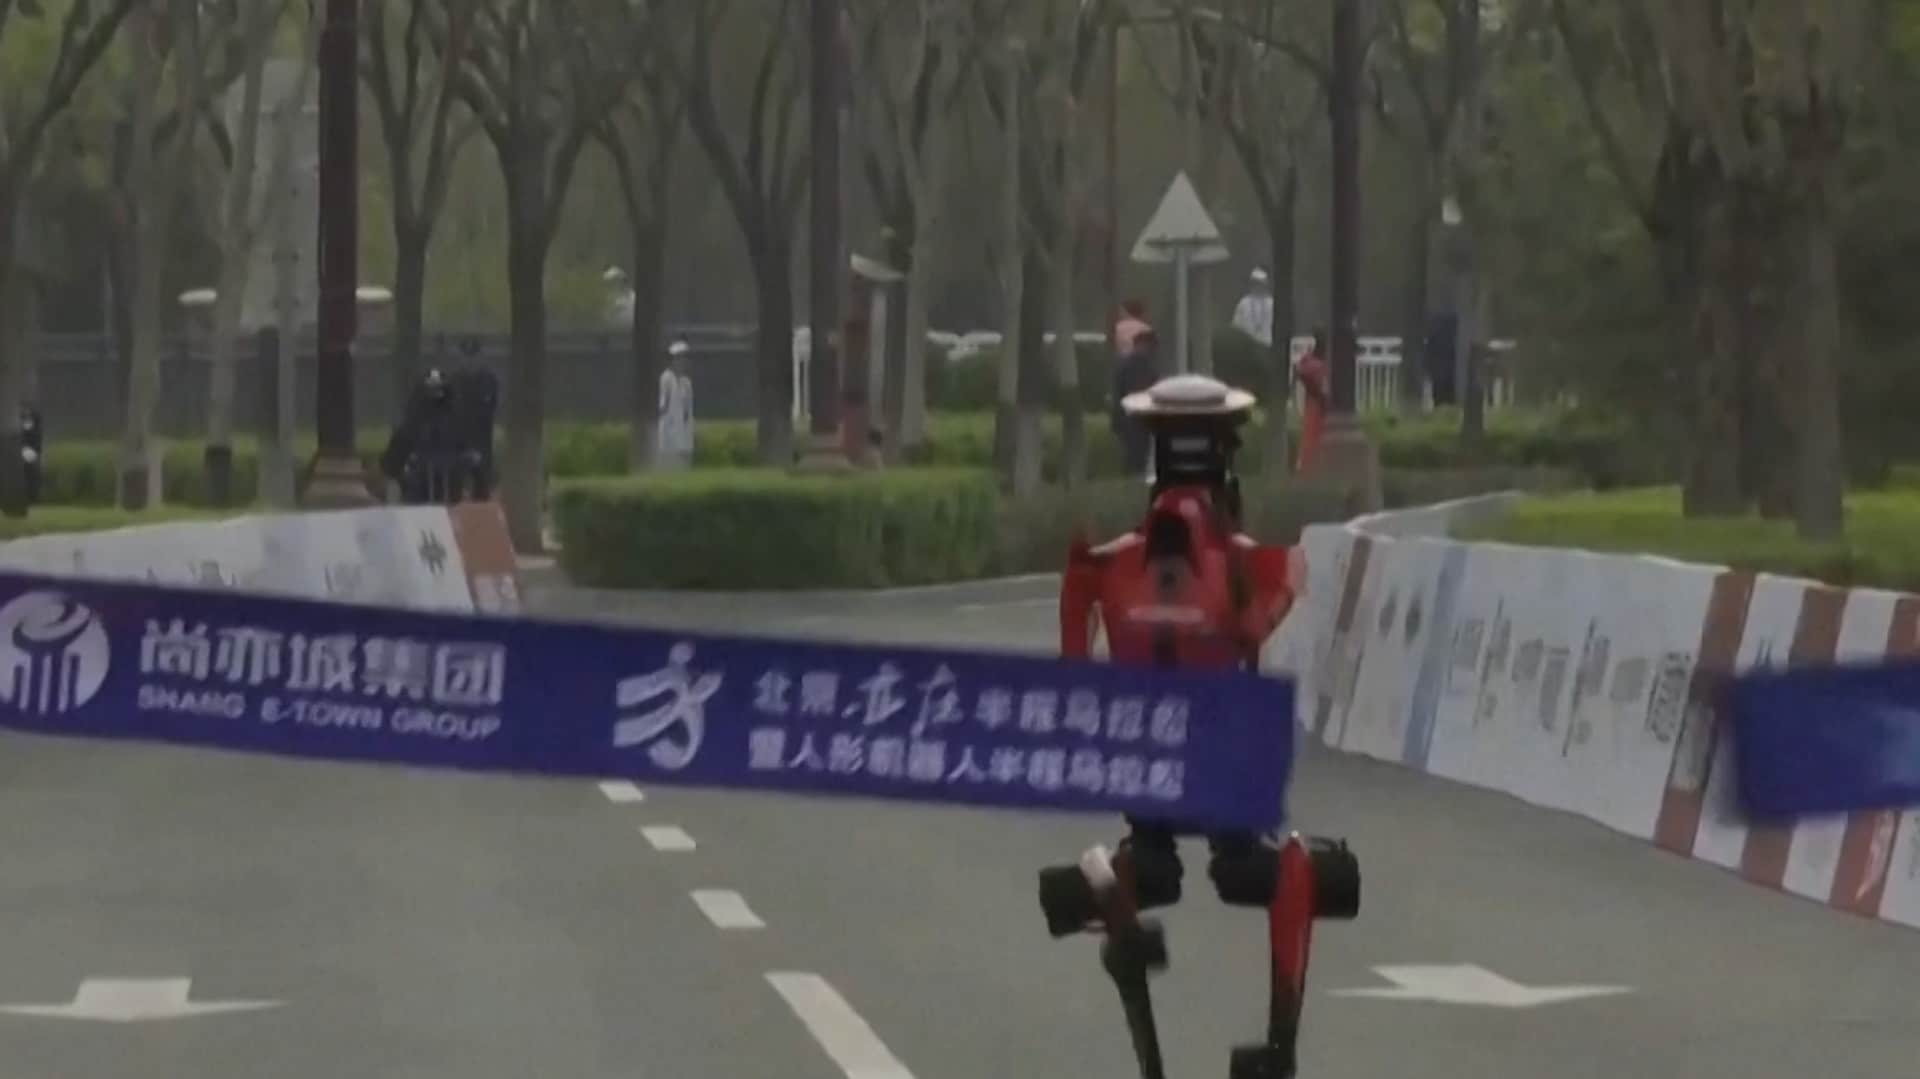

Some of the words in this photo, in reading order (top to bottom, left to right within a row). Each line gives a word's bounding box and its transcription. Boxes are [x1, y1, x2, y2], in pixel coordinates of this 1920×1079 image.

[139, 618, 506, 706] 尚亦城集团
[138, 683, 246, 719] SHANG
[260, 696, 383, 730] E-TOWN
[391, 706, 501, 742] GROUP
